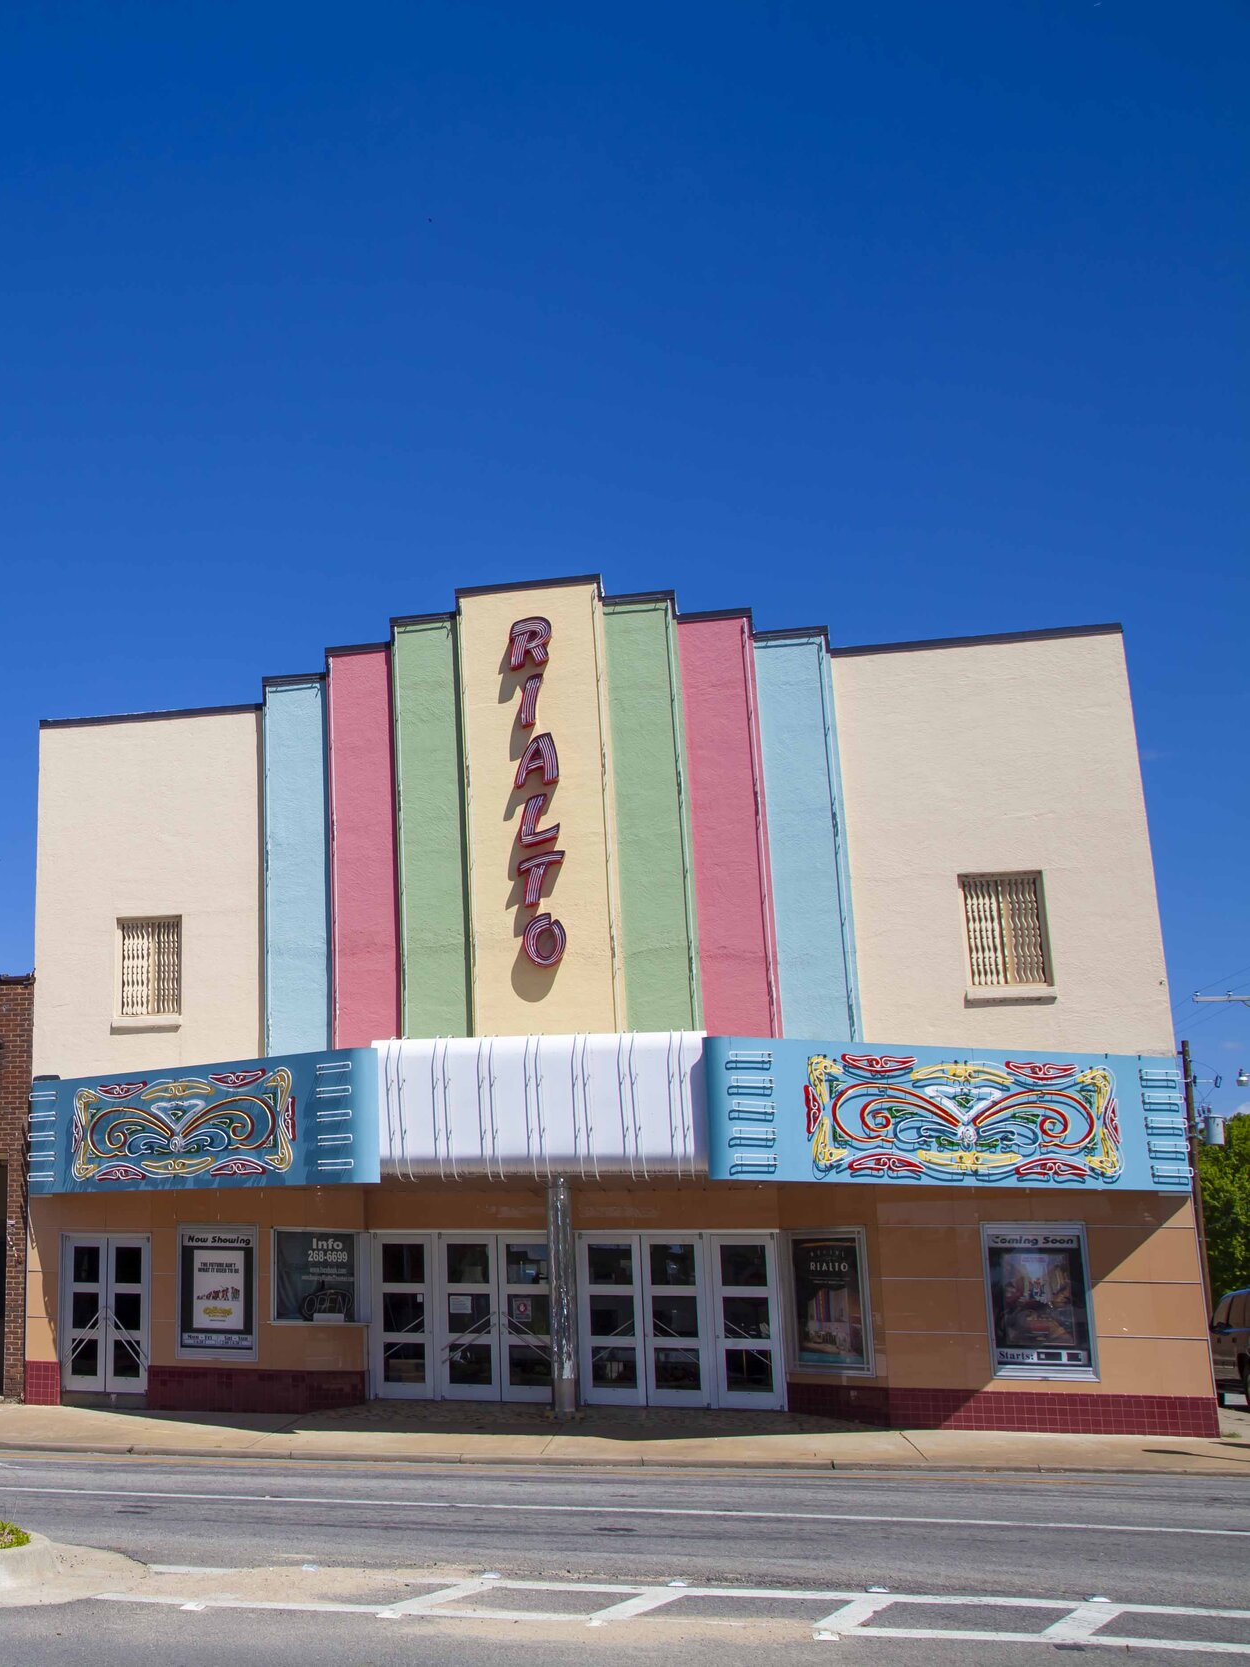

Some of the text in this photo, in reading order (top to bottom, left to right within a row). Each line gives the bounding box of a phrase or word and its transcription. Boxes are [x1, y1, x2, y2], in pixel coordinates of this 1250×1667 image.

[509, 616, 567, 968] RIALTO
[187, 1235, 252, 1246] Now Showing
[312, 1238, 343, 1249] Info
[992, 1235, 1074, 1246] Coming Soon
[308, 1250, 348, 1262] 268-6699
[810, 1262, 848, 1272] RIALTO
[304, 1295, 349, 1314] OPEN
[998, 1350, 1034, 1360] Starts:
